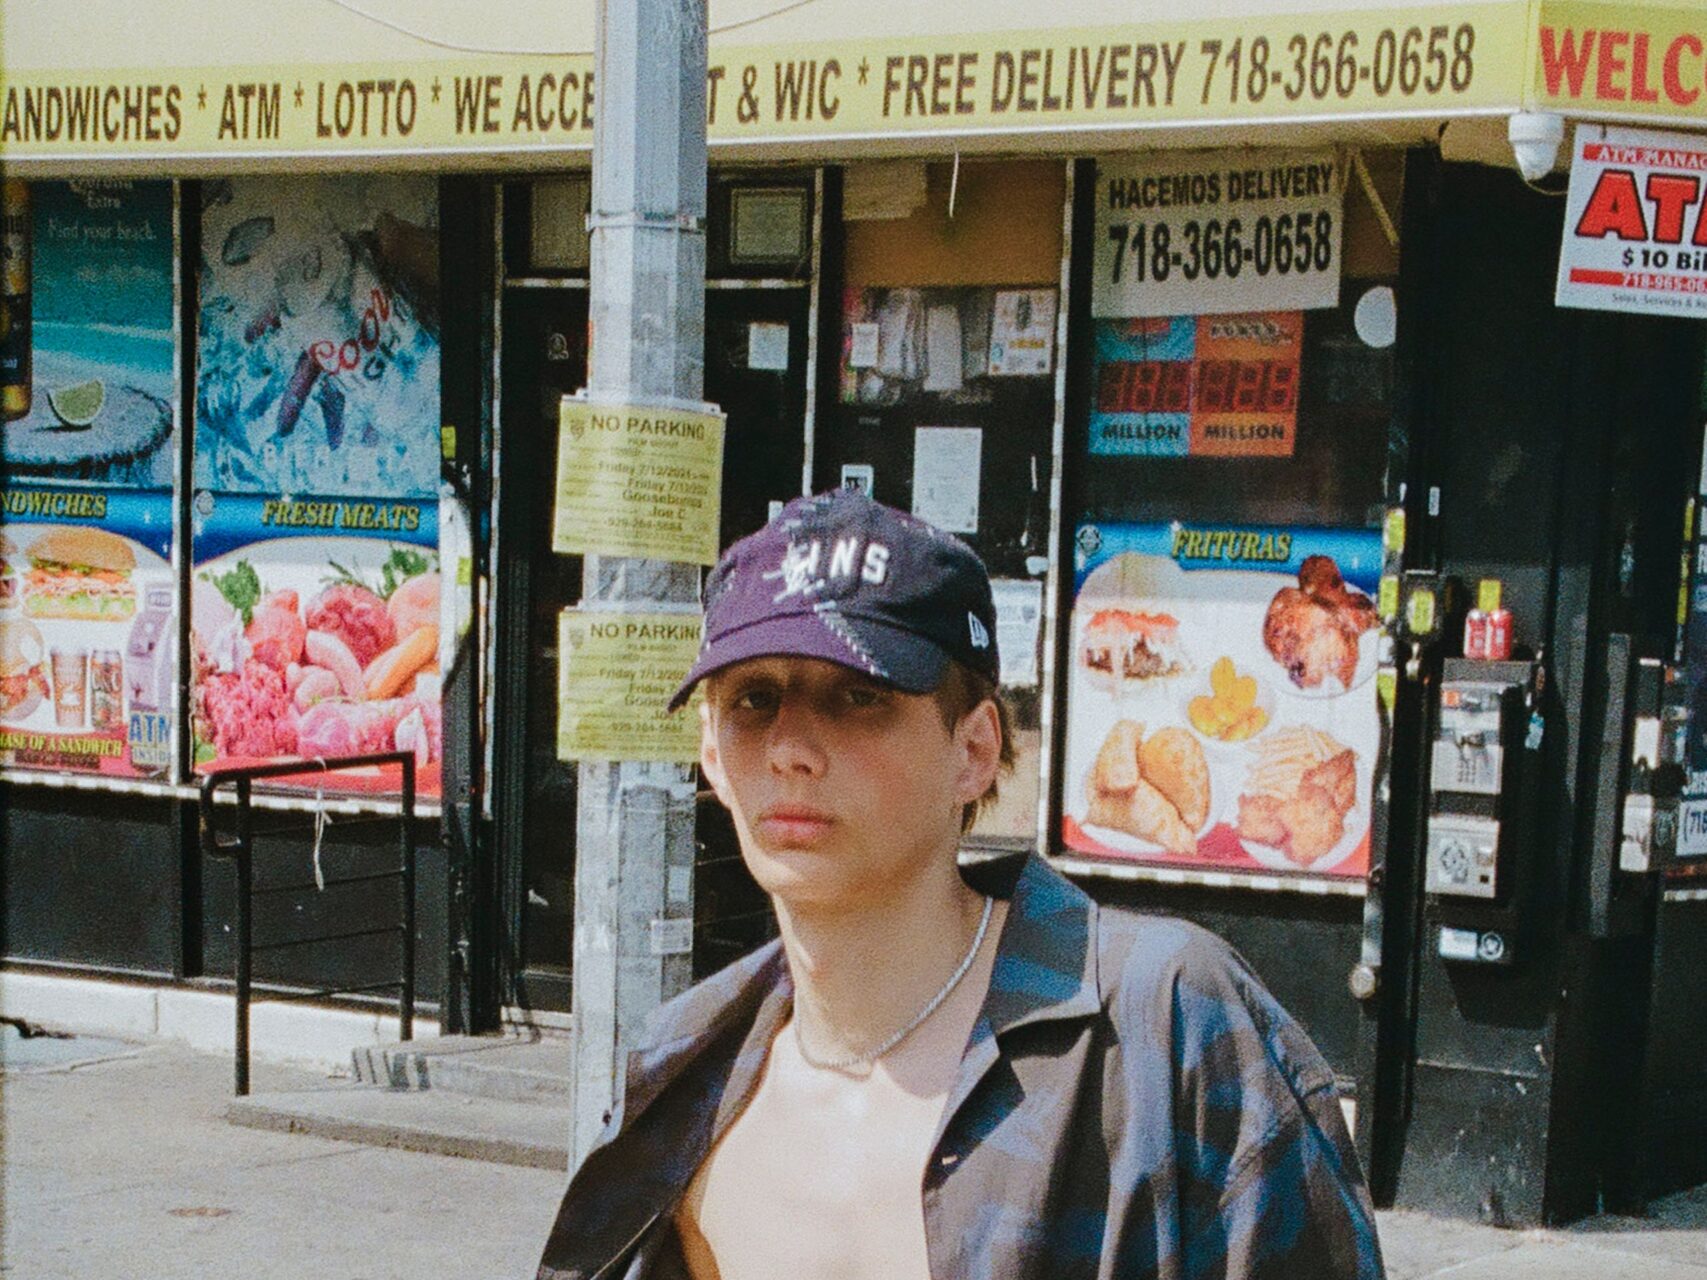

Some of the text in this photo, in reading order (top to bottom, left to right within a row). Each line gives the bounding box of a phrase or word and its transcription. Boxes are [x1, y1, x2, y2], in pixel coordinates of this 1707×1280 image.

[1539, 26, 1707, 107] WELC
[1, 84, 182, 142] ANDWICHES
[218, 82, 281, 140] ATM
[315, 79, 416, 138] LOTTO
[454, 75, 503, 134] WE
[512, 71, 594, 132] ACCE
[737, 64, 760, 124] &
[774, 58, 842, 121] WIC
[882, 52, 978, 118] FREE
[991, 41, 1185, 112] DELIVERY
[1200, 23, 1475, 104] 718-366-0658
[1600, 146, 1638, 164] ATM
[1109, 164, 1332, 207] HACEMOS DELIVERY
[1575, 170, 1707, 245] AT
[1109, 210, 1332, 284] 718-366-0658
[591, 414, 706, 442] NO PARKING
[1103, 423, 1285, 441] MILLION MILLION
[262, 500, 420, 531] FRESH MEATS
[1172, 529, 1292, 561] FRITURAS
[590, 622, 620, 638] NO
[29, 734, 46, 750] OF
[59, 737, 122, 757] SANDWICH
